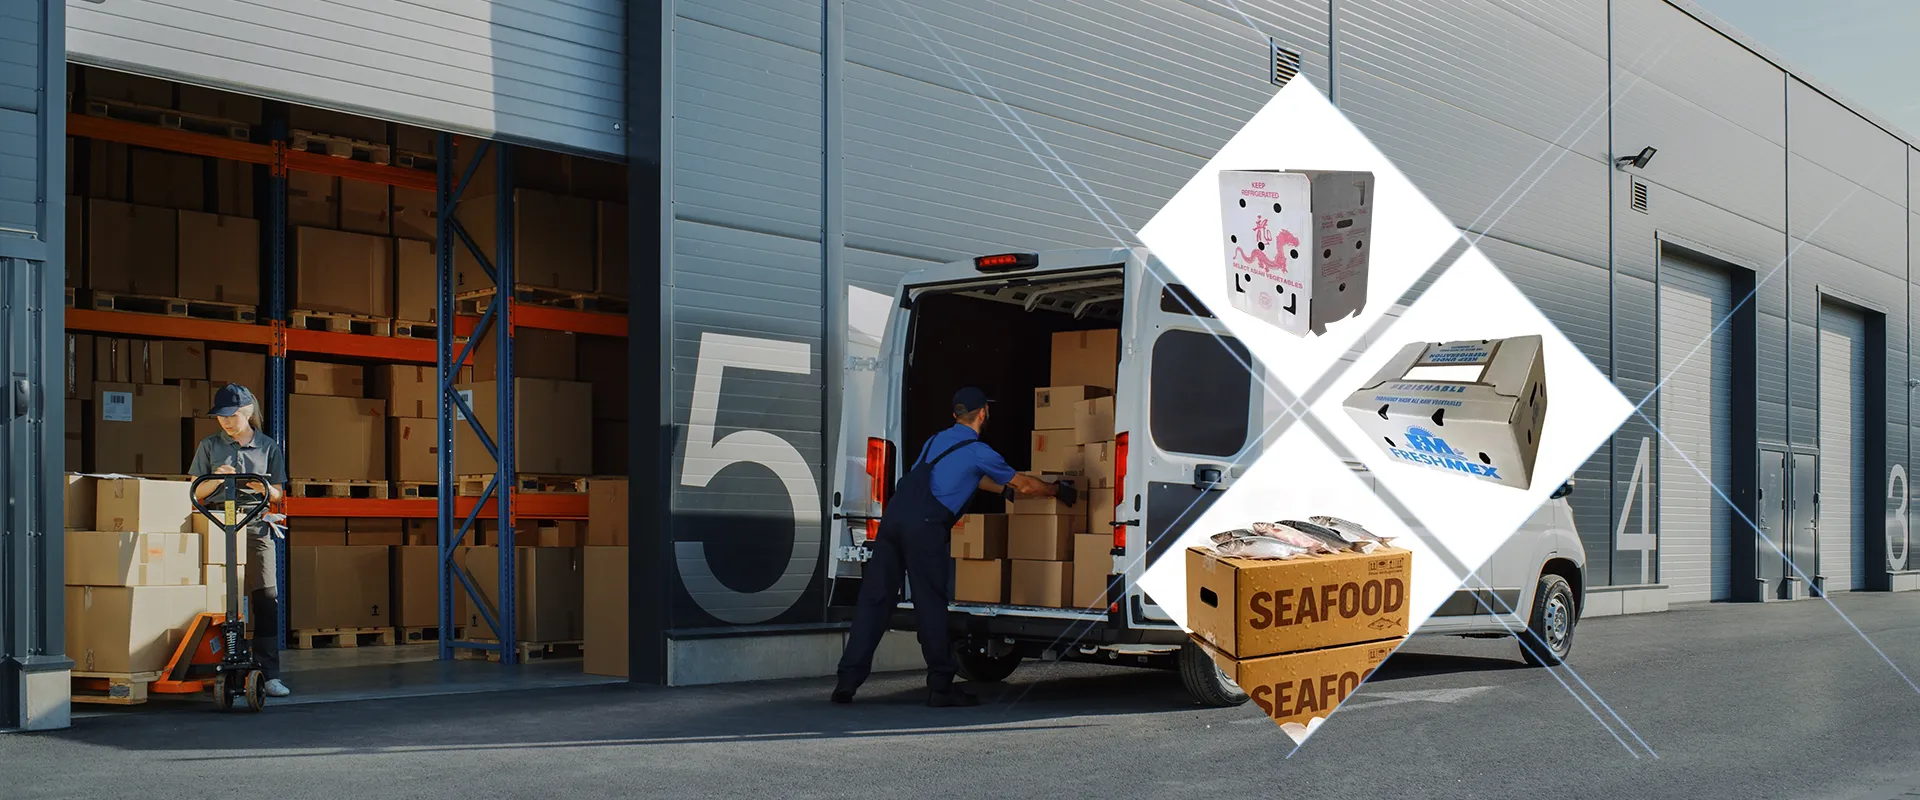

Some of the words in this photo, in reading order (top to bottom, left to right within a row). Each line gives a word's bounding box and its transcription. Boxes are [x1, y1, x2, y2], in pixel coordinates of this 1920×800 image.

[1241, 189, 1279, 199] REFRIGERATED
[1233, 262, 1250, 272] SELECT
[1250, 267, 1266, 277] ASIAN
[1266, 272, 1303, 289] VEGETABLES
[1390, 384, 1466, 393] PERISHABLE
[674, 332, 821, 624] 5
[1389, 447, 1502, 479] FRESHMEX
[1616, 437, 1656, 583] 4
[1886, 464, 1908, 570] 3
[1250, 578, 1404, 630] SEAFOOD
[1251, 668, 1376, 719] SEAFO
